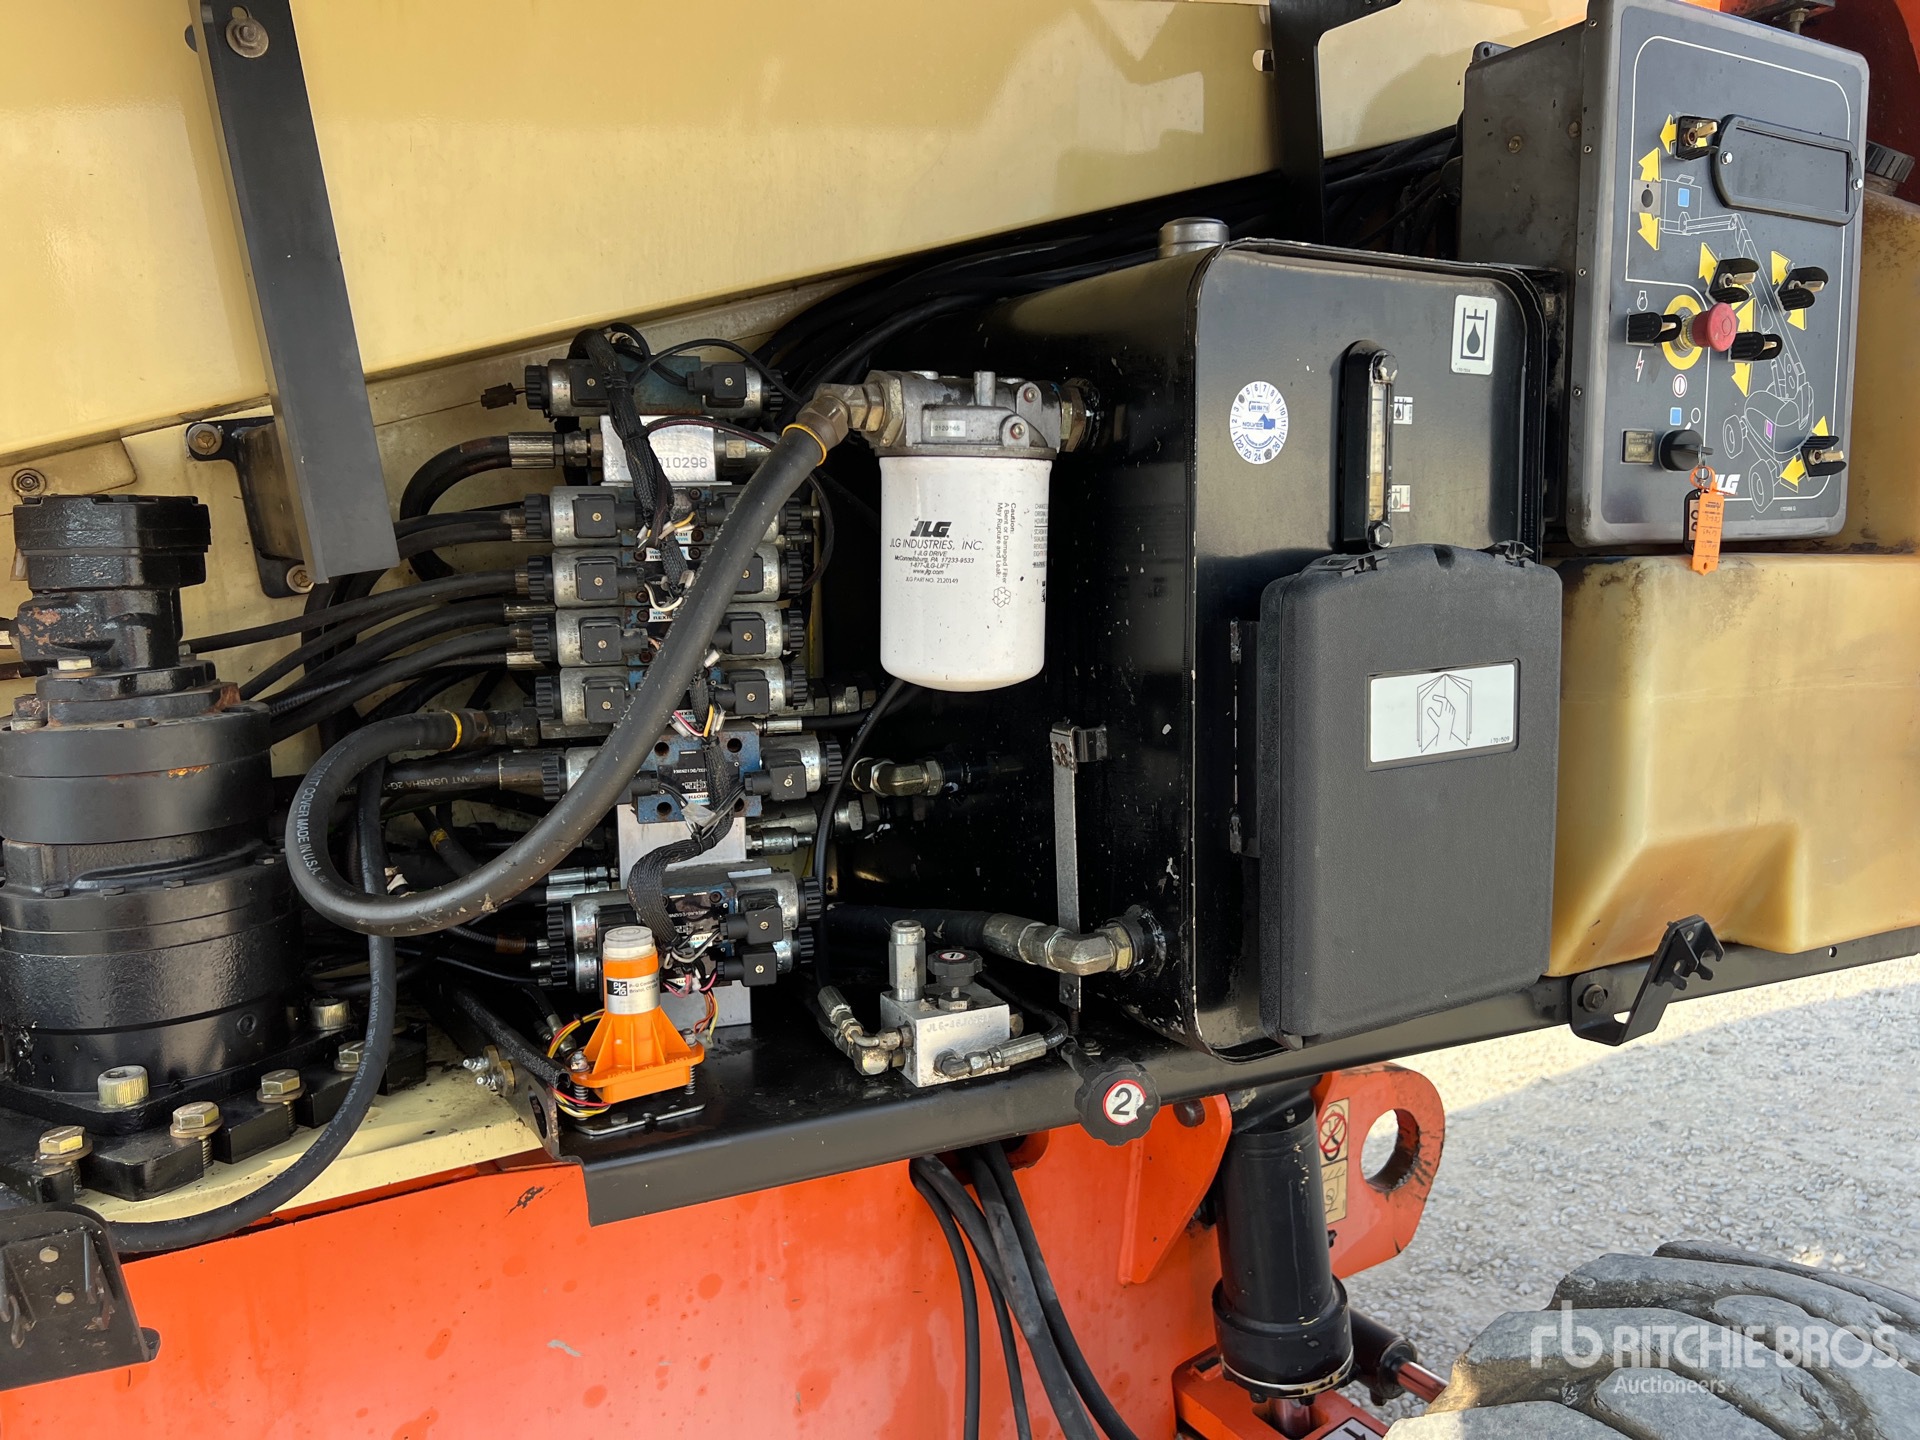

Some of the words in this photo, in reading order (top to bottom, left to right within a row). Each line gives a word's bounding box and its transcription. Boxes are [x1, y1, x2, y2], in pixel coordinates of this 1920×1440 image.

[1245, 387, 1251, 396] 5
[1254, 384, 1259, 392] 6
[1262, 384, 1267, 392] 7
[1280, 407, 1286, 416] 10
[1244, 448, 1252, 460] 23
[1254, 453, 1262, 462] 24
[910, 520, 953, 538] JLG
[889, 538, 902, 549] JLG
[903, 539, 955, 551] INDUSTRIES,
[961, 540, 984, 551] INC.
[299, 787, 316, 818] COVER
[296, 818, 310, 844] MADE
[299, 844, 312, 854] IN
[302, 852, 322, 876] U.S.A.
[366, 1027, 376, 1048] SAE
[1112, 1087, 1132, 1116] 2
